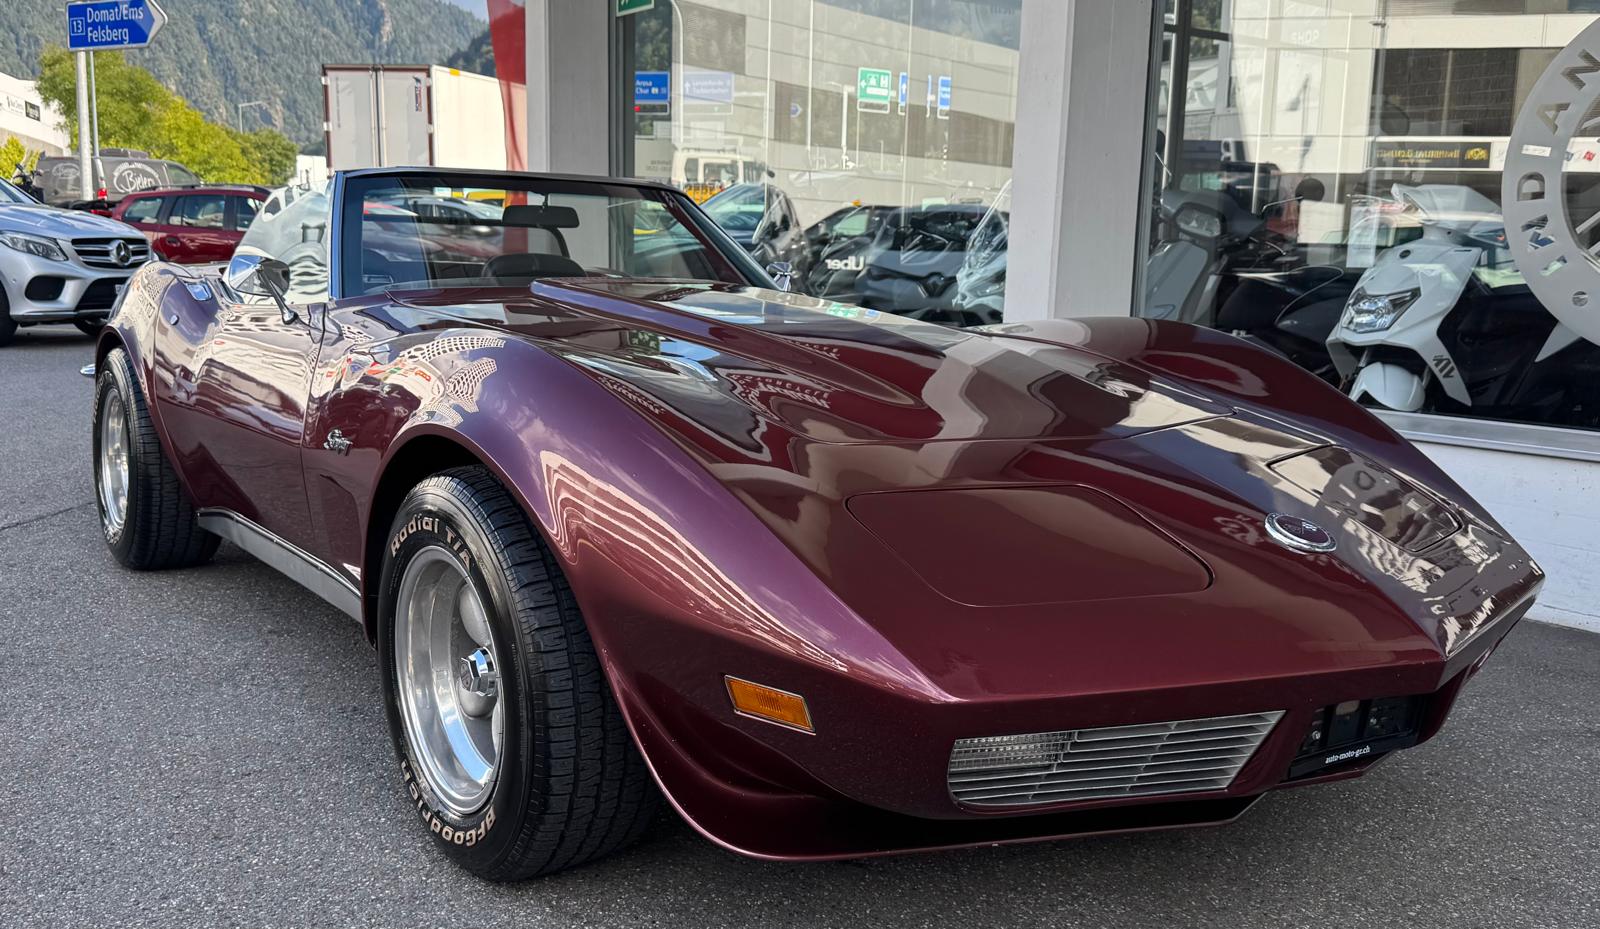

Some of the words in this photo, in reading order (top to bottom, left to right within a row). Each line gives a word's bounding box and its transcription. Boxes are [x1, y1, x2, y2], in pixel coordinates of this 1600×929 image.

[86, 5, 144, 23] Domat/Ems
[73, 20, 83, 33] 13
[87, 25, 129, 44] Felsberg
[1325, 745, 1370, 764] auto-moto-gr.ch
[401, 759, 497, 846] BFGoodrich
